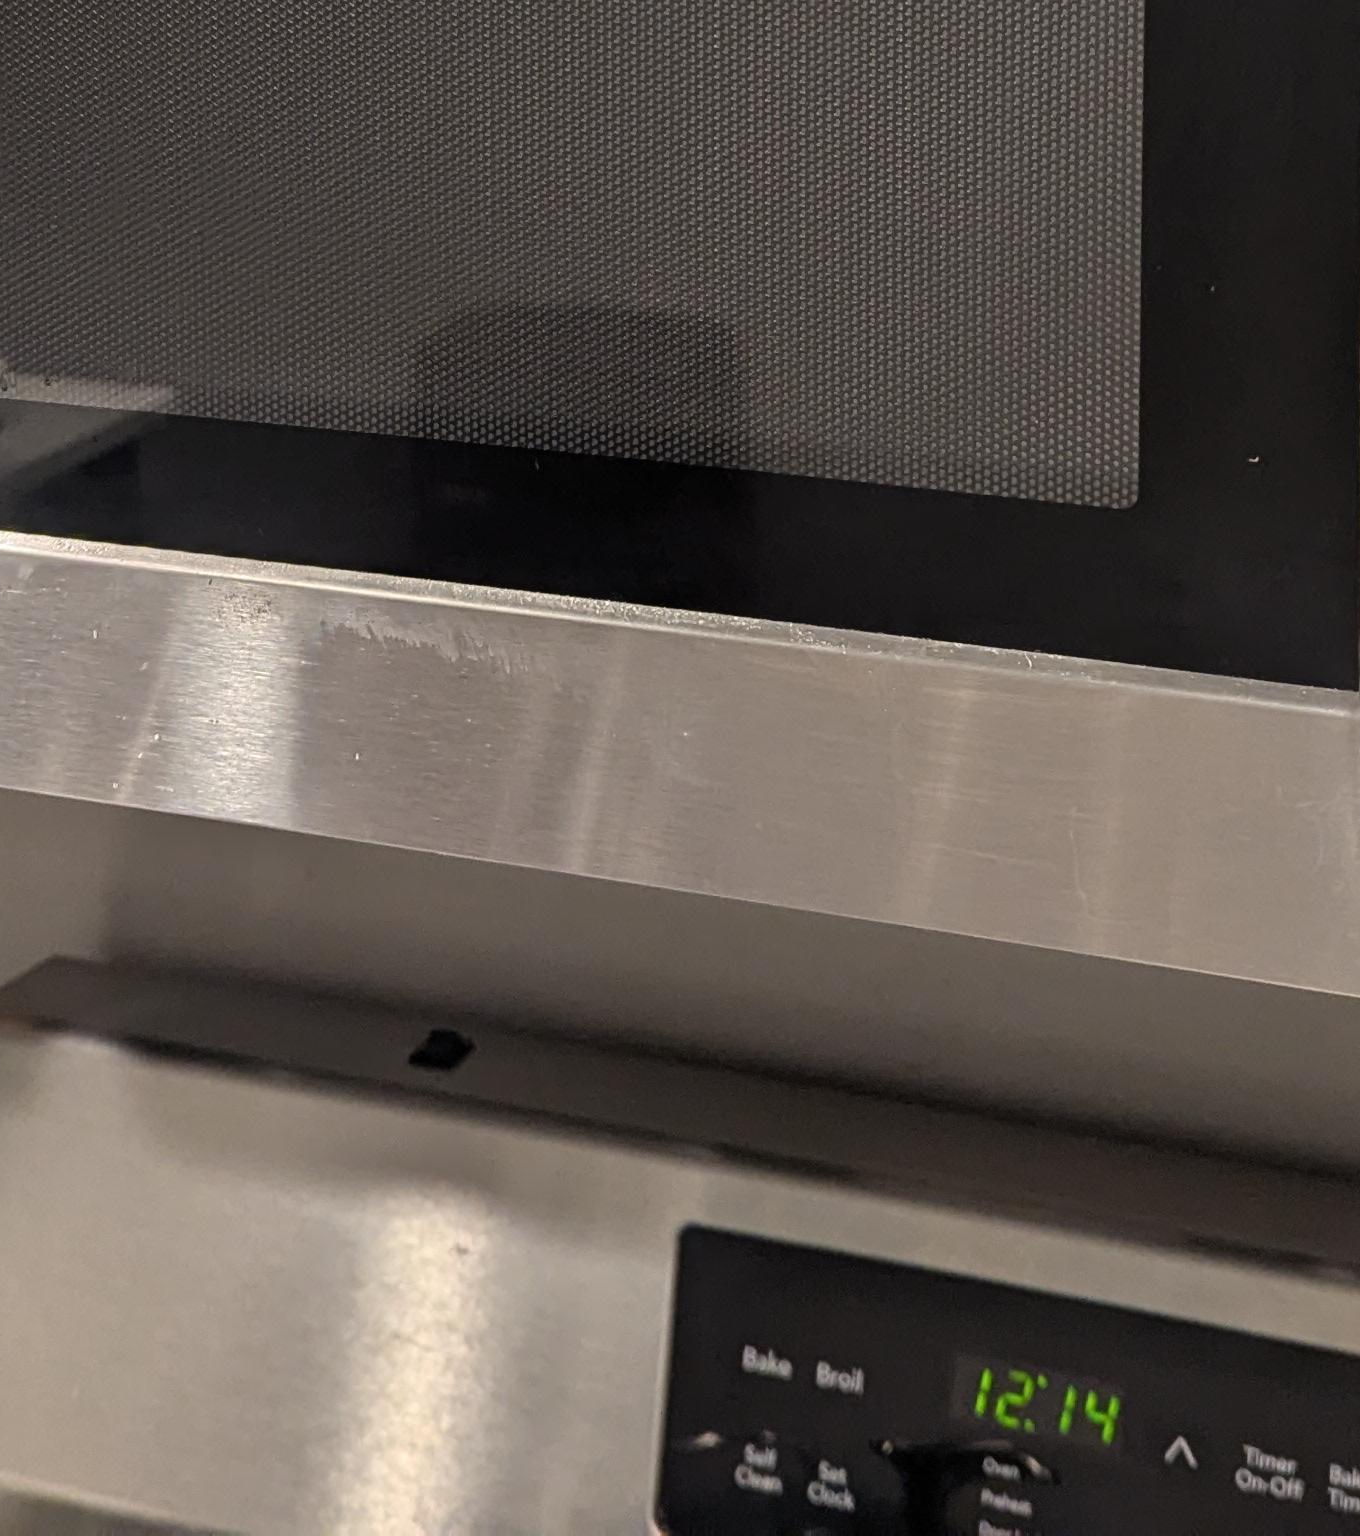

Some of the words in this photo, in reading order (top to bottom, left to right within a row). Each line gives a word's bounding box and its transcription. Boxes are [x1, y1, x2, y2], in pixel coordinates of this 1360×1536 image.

[742, 1344, 793, 1381] Bake
[816, 1361, 865, 1396] Broil
[974, 1367, 1120, 1445] 12:14
[1243, 1444, 1298, 1476] Timer
